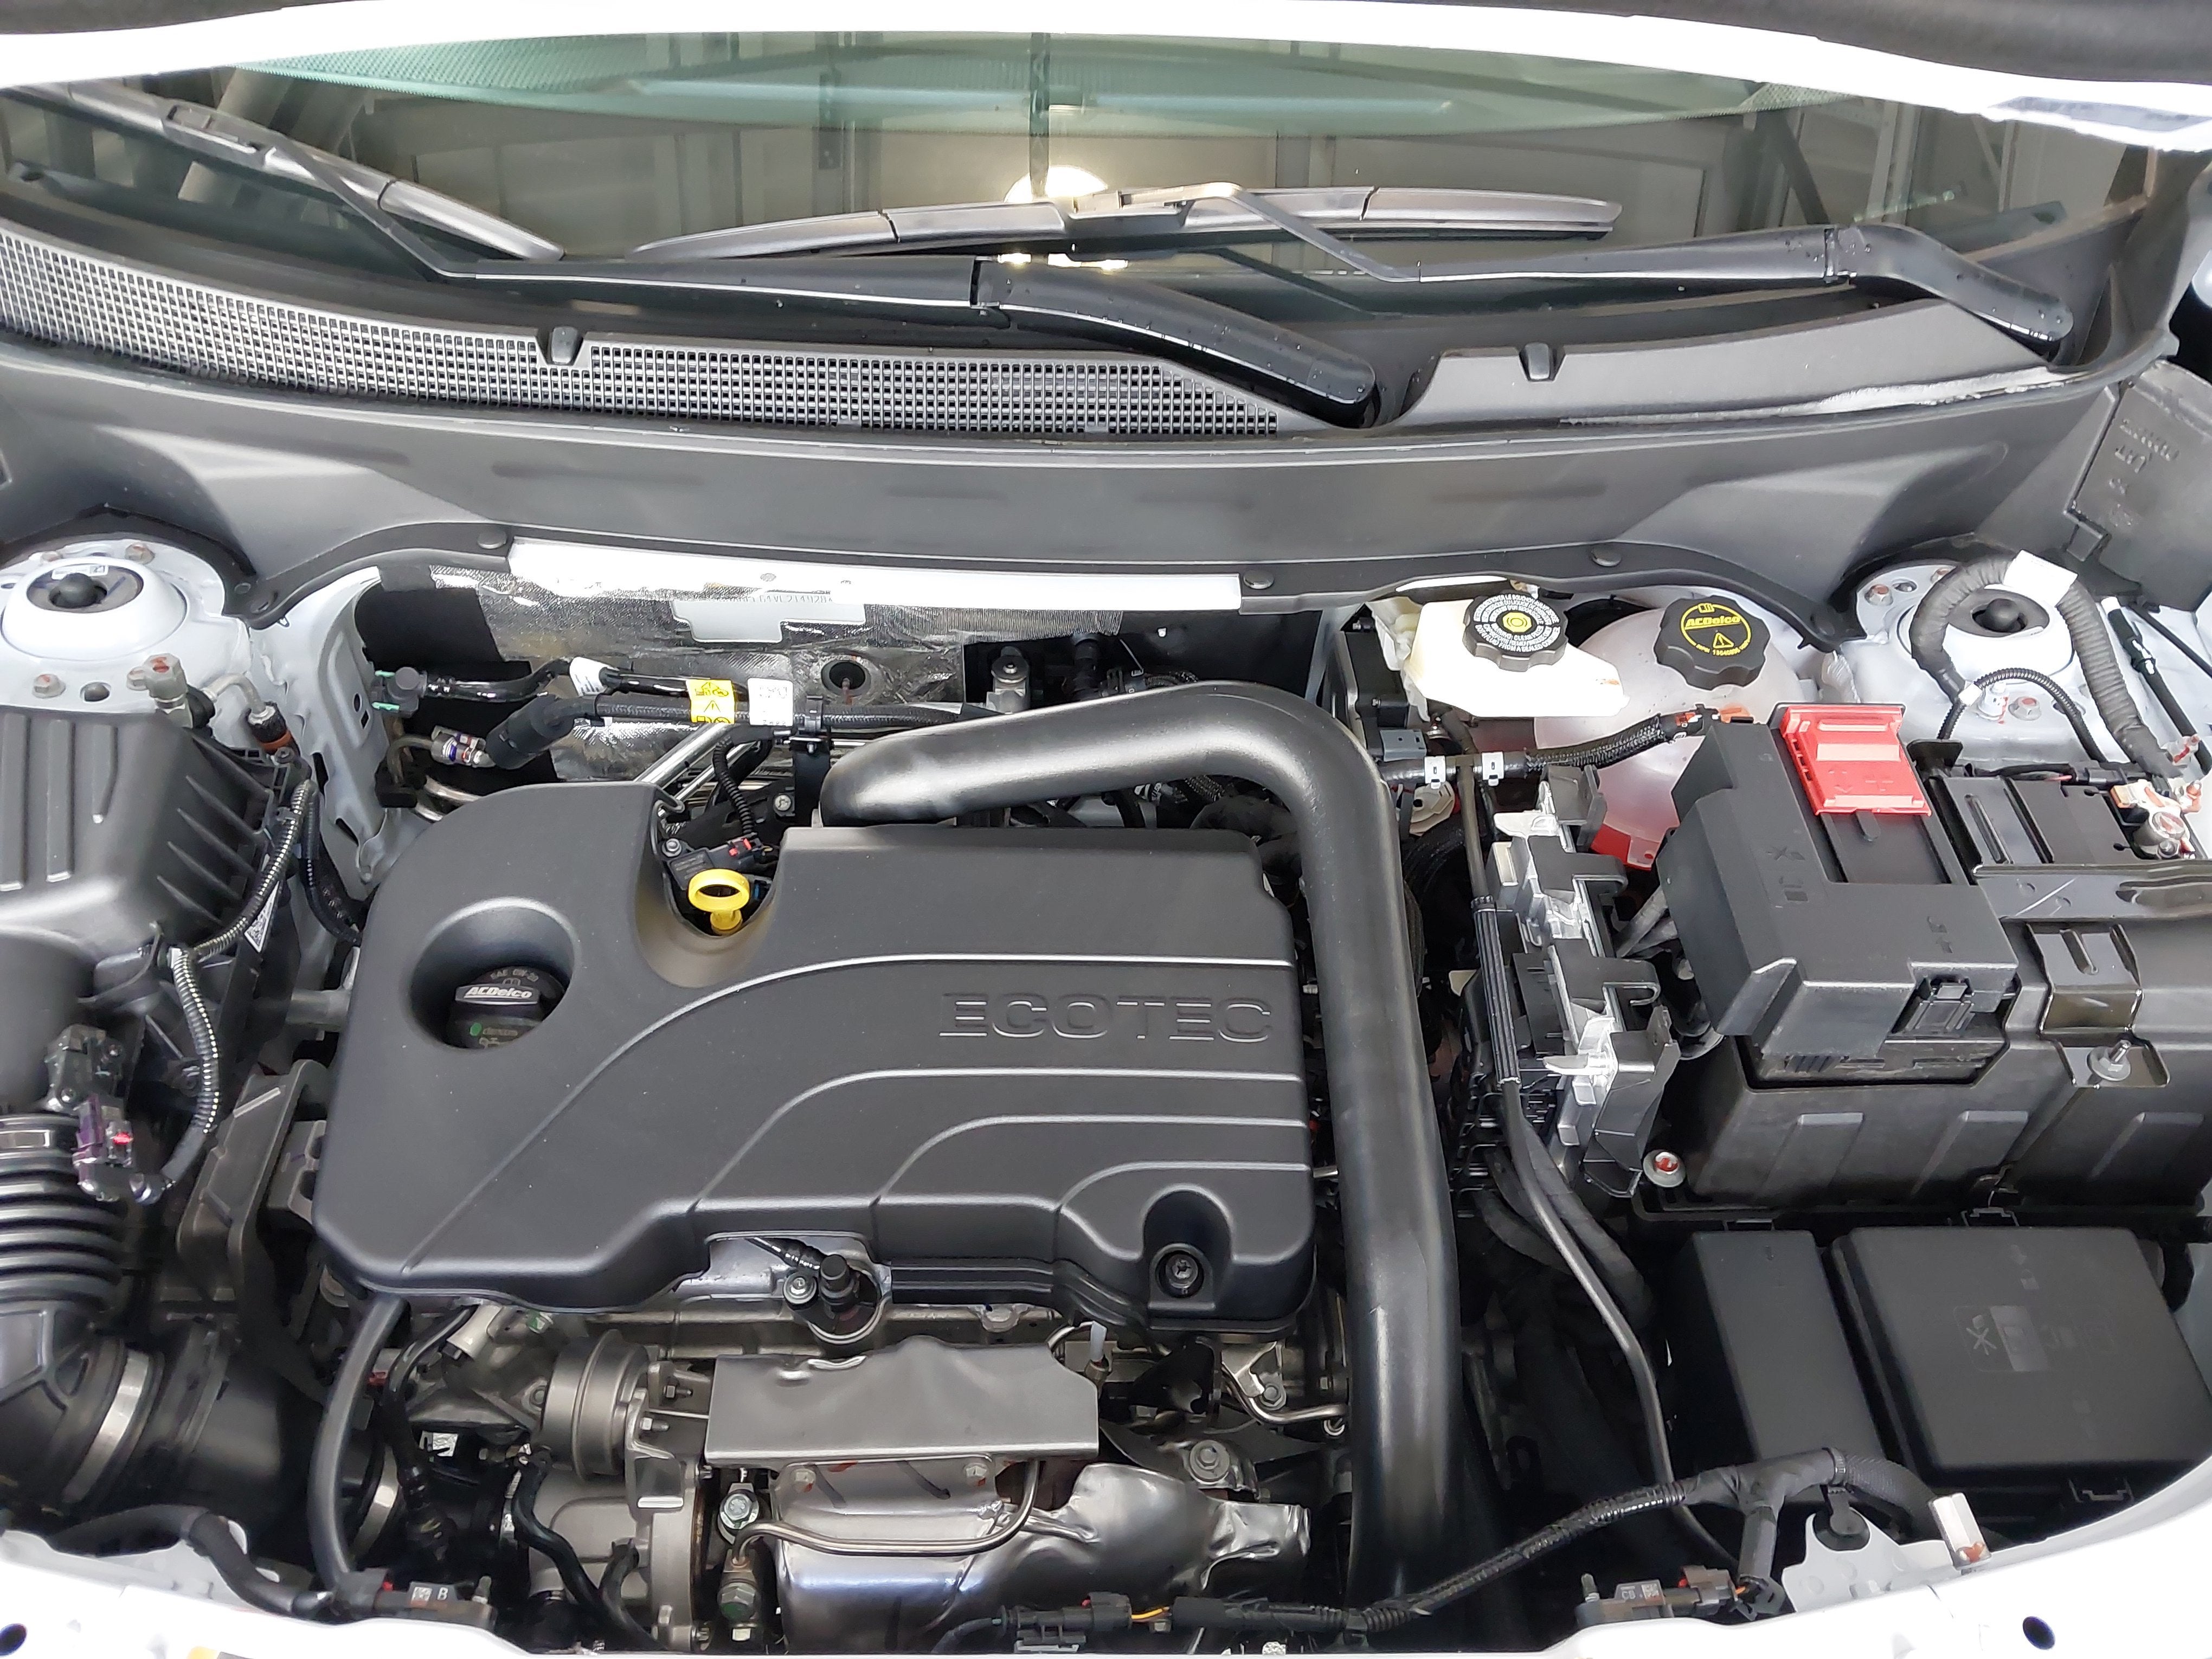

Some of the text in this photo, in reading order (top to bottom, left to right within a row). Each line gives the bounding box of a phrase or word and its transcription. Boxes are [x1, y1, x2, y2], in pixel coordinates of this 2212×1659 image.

[1685, 615, 1740, 627] ACDelco
[465, 986, 532, 998] ACDelco
[940, 993, 1272, 1043] ECOTEC
